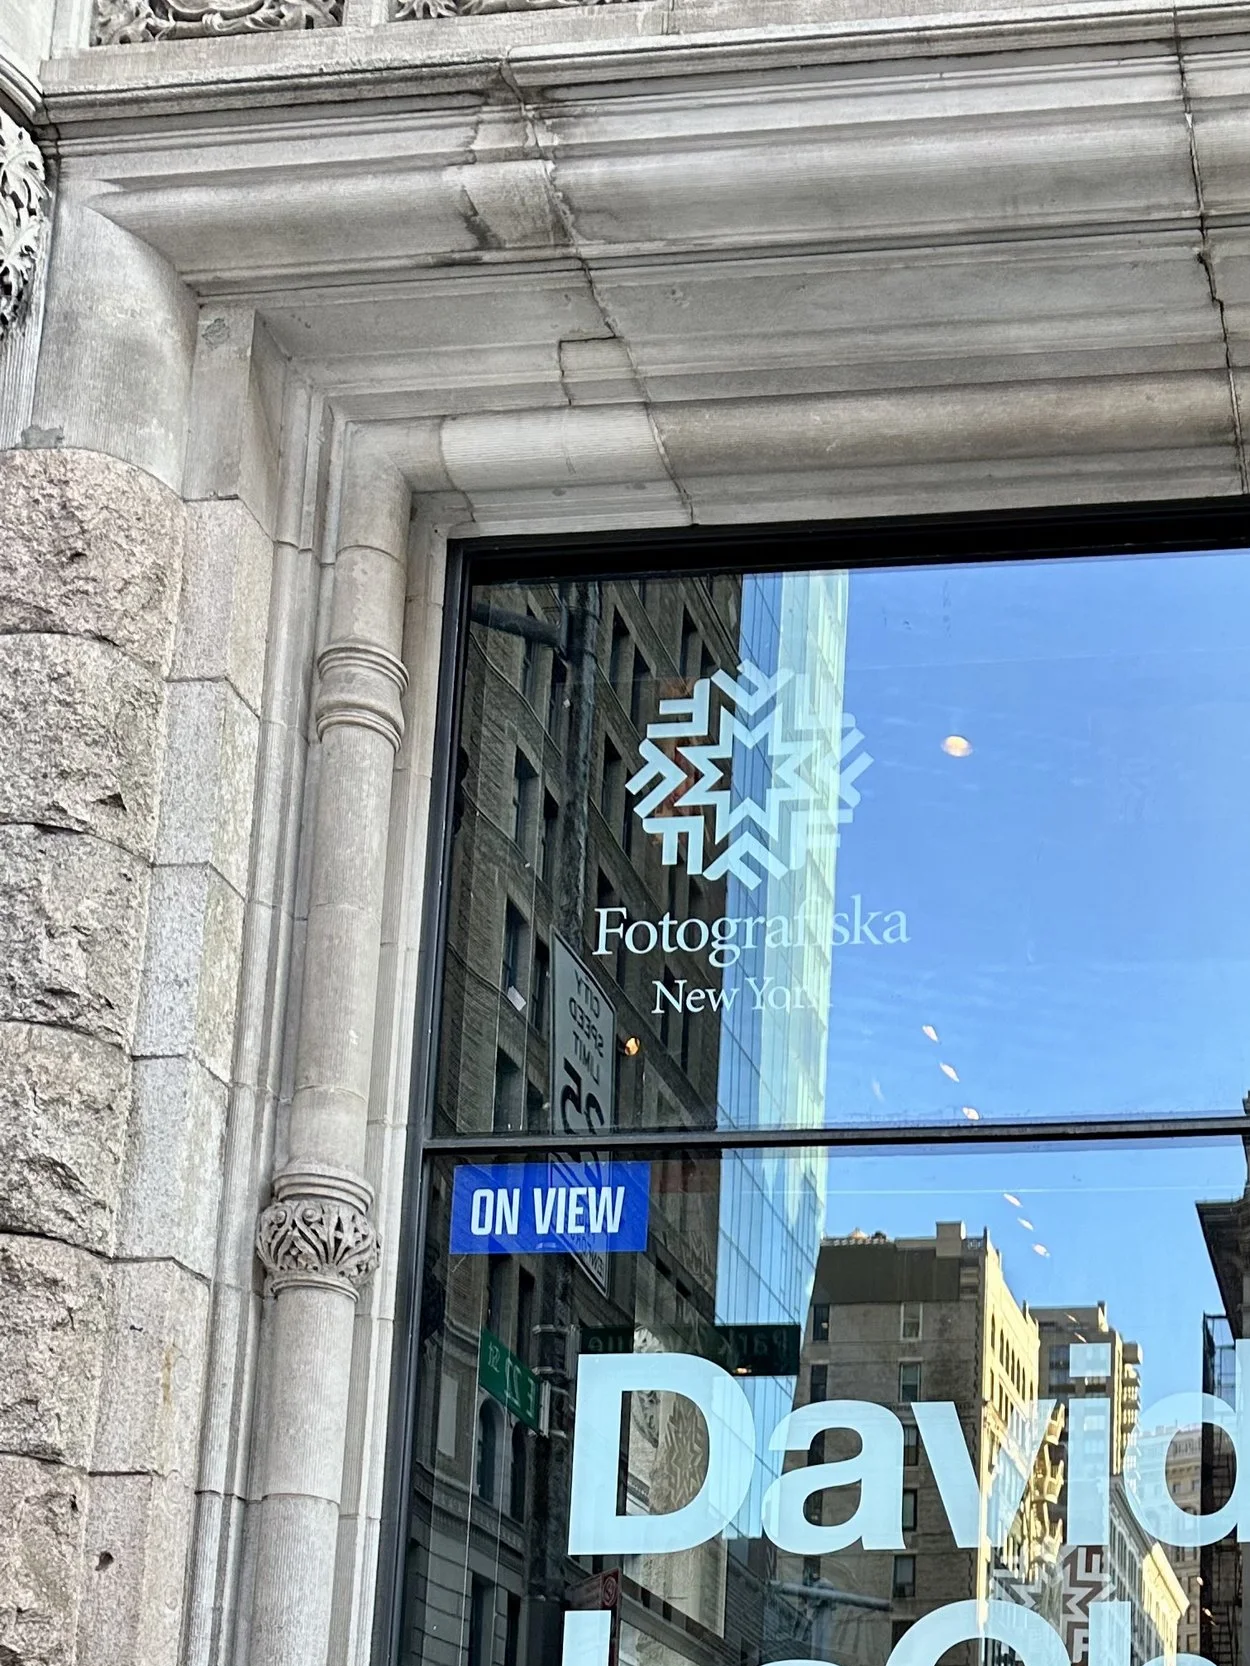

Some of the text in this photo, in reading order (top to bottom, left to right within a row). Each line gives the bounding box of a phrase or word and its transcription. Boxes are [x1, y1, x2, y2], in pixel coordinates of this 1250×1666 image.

[591, 894, 912, 967] Fotografiska
[651, 979, 740, 1014] New
[471, 1186, 625, 1235] ON VIEW
